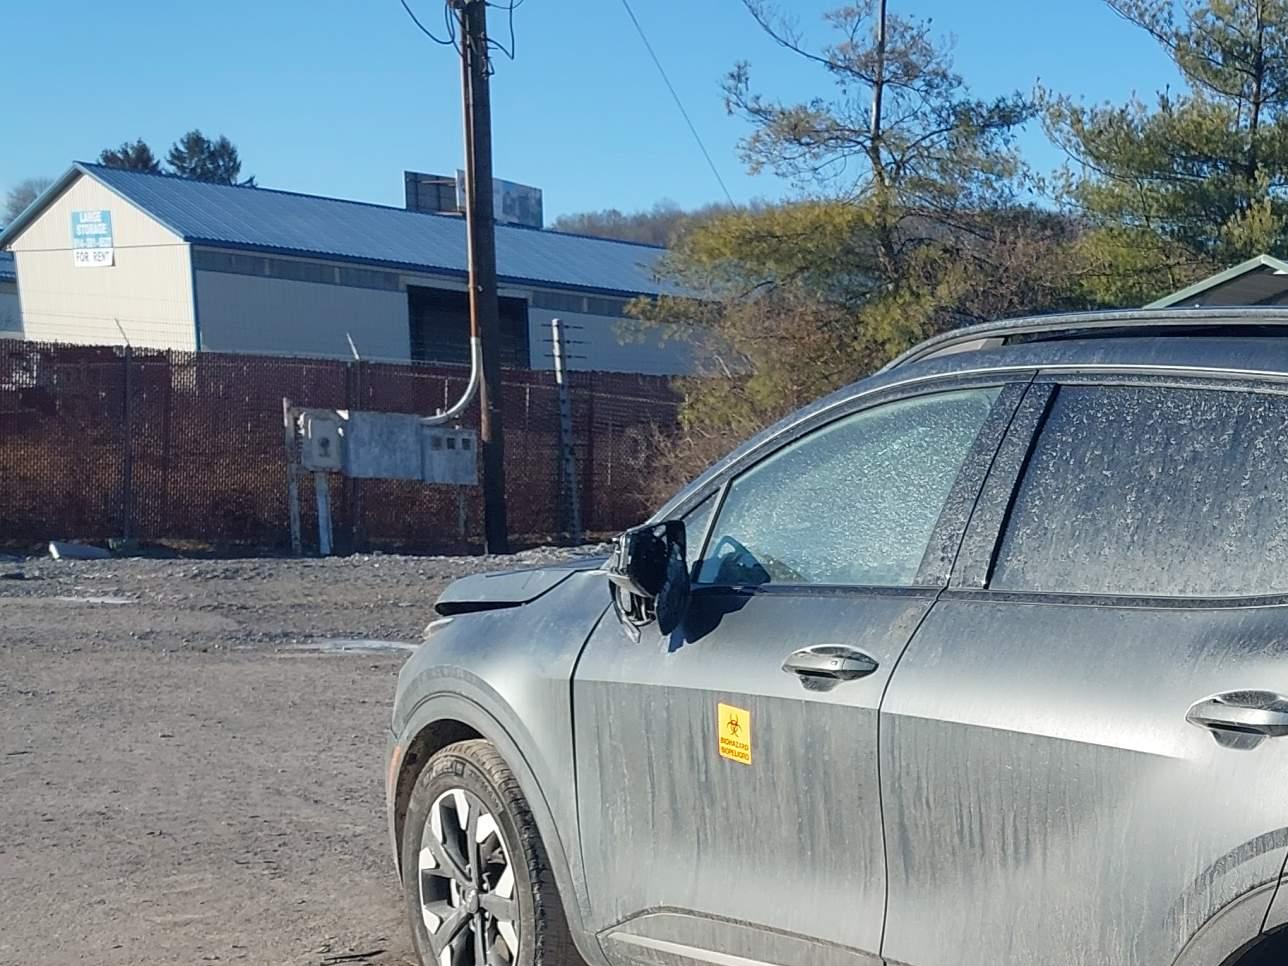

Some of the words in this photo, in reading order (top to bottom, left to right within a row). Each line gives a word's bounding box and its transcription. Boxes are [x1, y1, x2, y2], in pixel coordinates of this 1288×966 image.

[76, 250, 89, 263] FOR
[93, 250, 110, 263] RENT
[719, 736, 749, 751] BIOHAZARD
